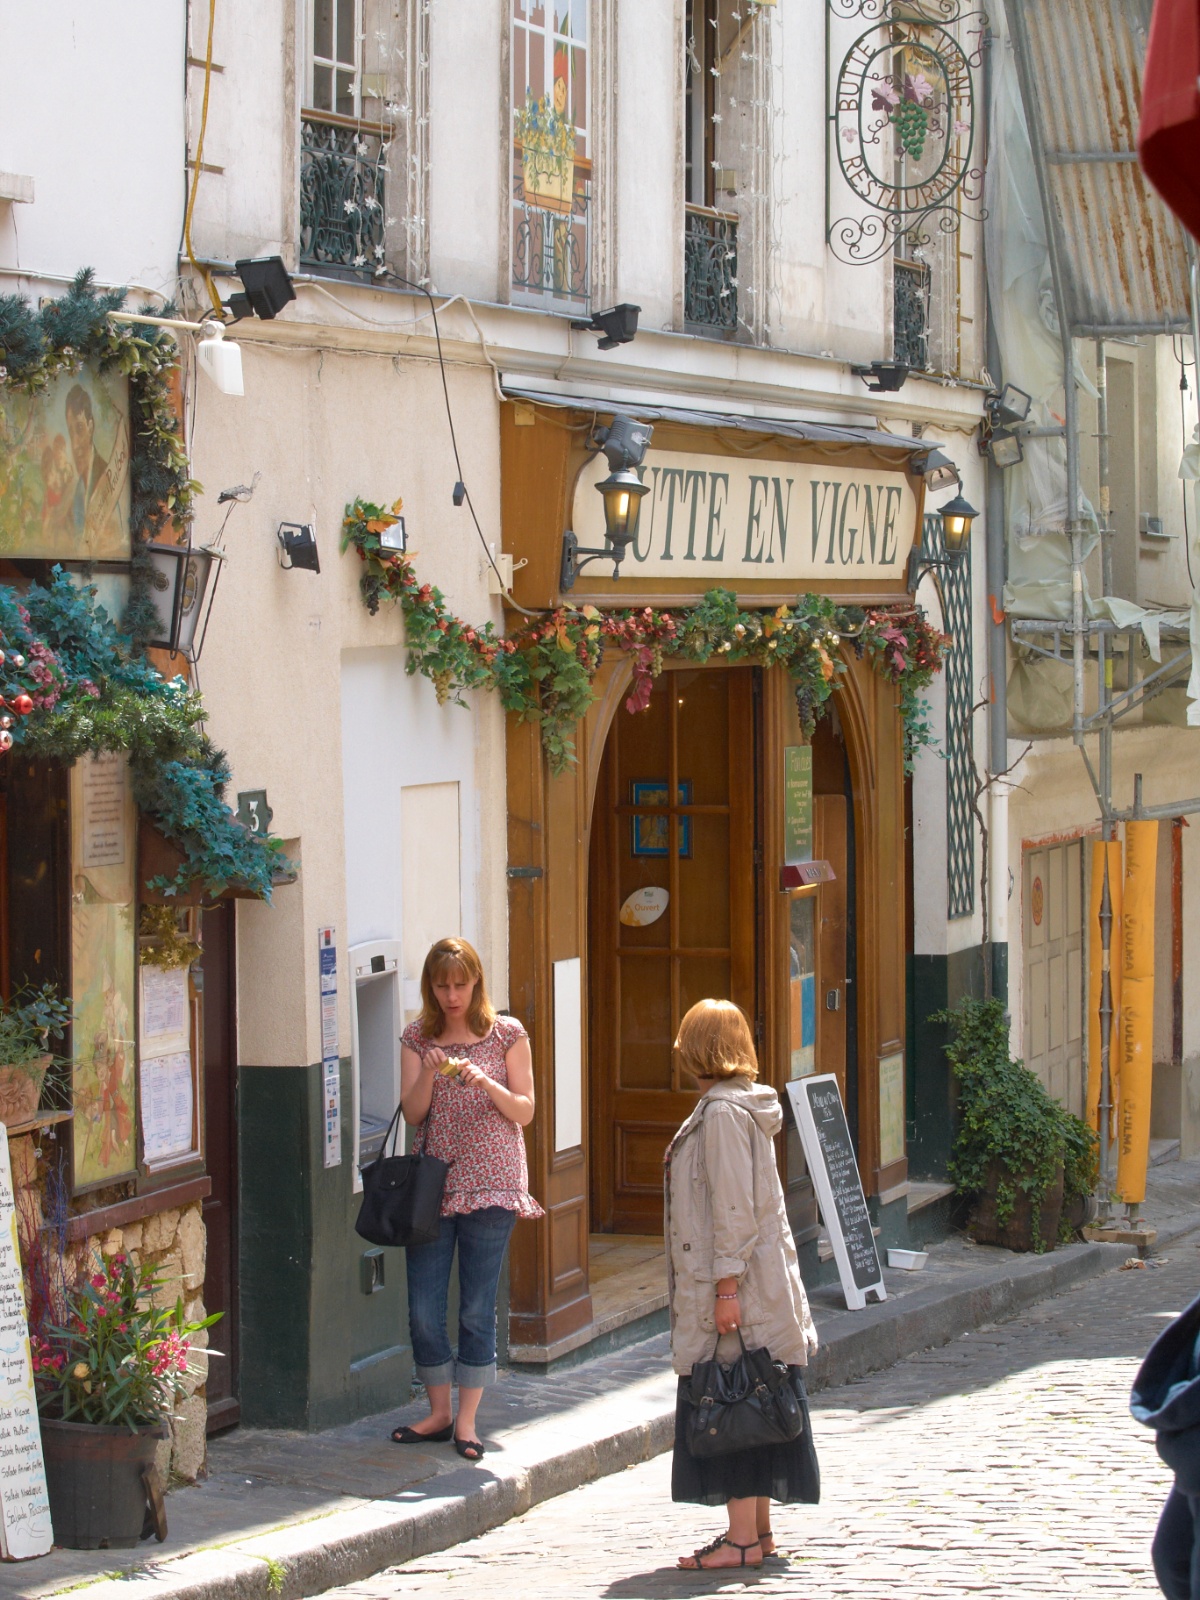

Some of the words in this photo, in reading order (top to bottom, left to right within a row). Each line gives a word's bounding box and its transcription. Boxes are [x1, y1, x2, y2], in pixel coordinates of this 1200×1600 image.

[838, 38, 877, 111] BUTTE
[886, 22, 922, 44] EN
[935, 34, 972, 108] VIGNE
[841, 148, 967, 210] RESTAURANT
[606, 465, 730, 563] UTTE
[741, 475, 794, 564] EN
[809, 480, 903, 566] VIGNE
[634, 903, 660, 912] Ouvert
[1125, 1024, 1134, 1064] ULMA
[1122, 1116, 1132, 1156] ULMA
[1, 1464, 17, 1479] Salade
[4, 1488, 20, 1502] Salade
[7, 1506, 28, 1528] Salade
